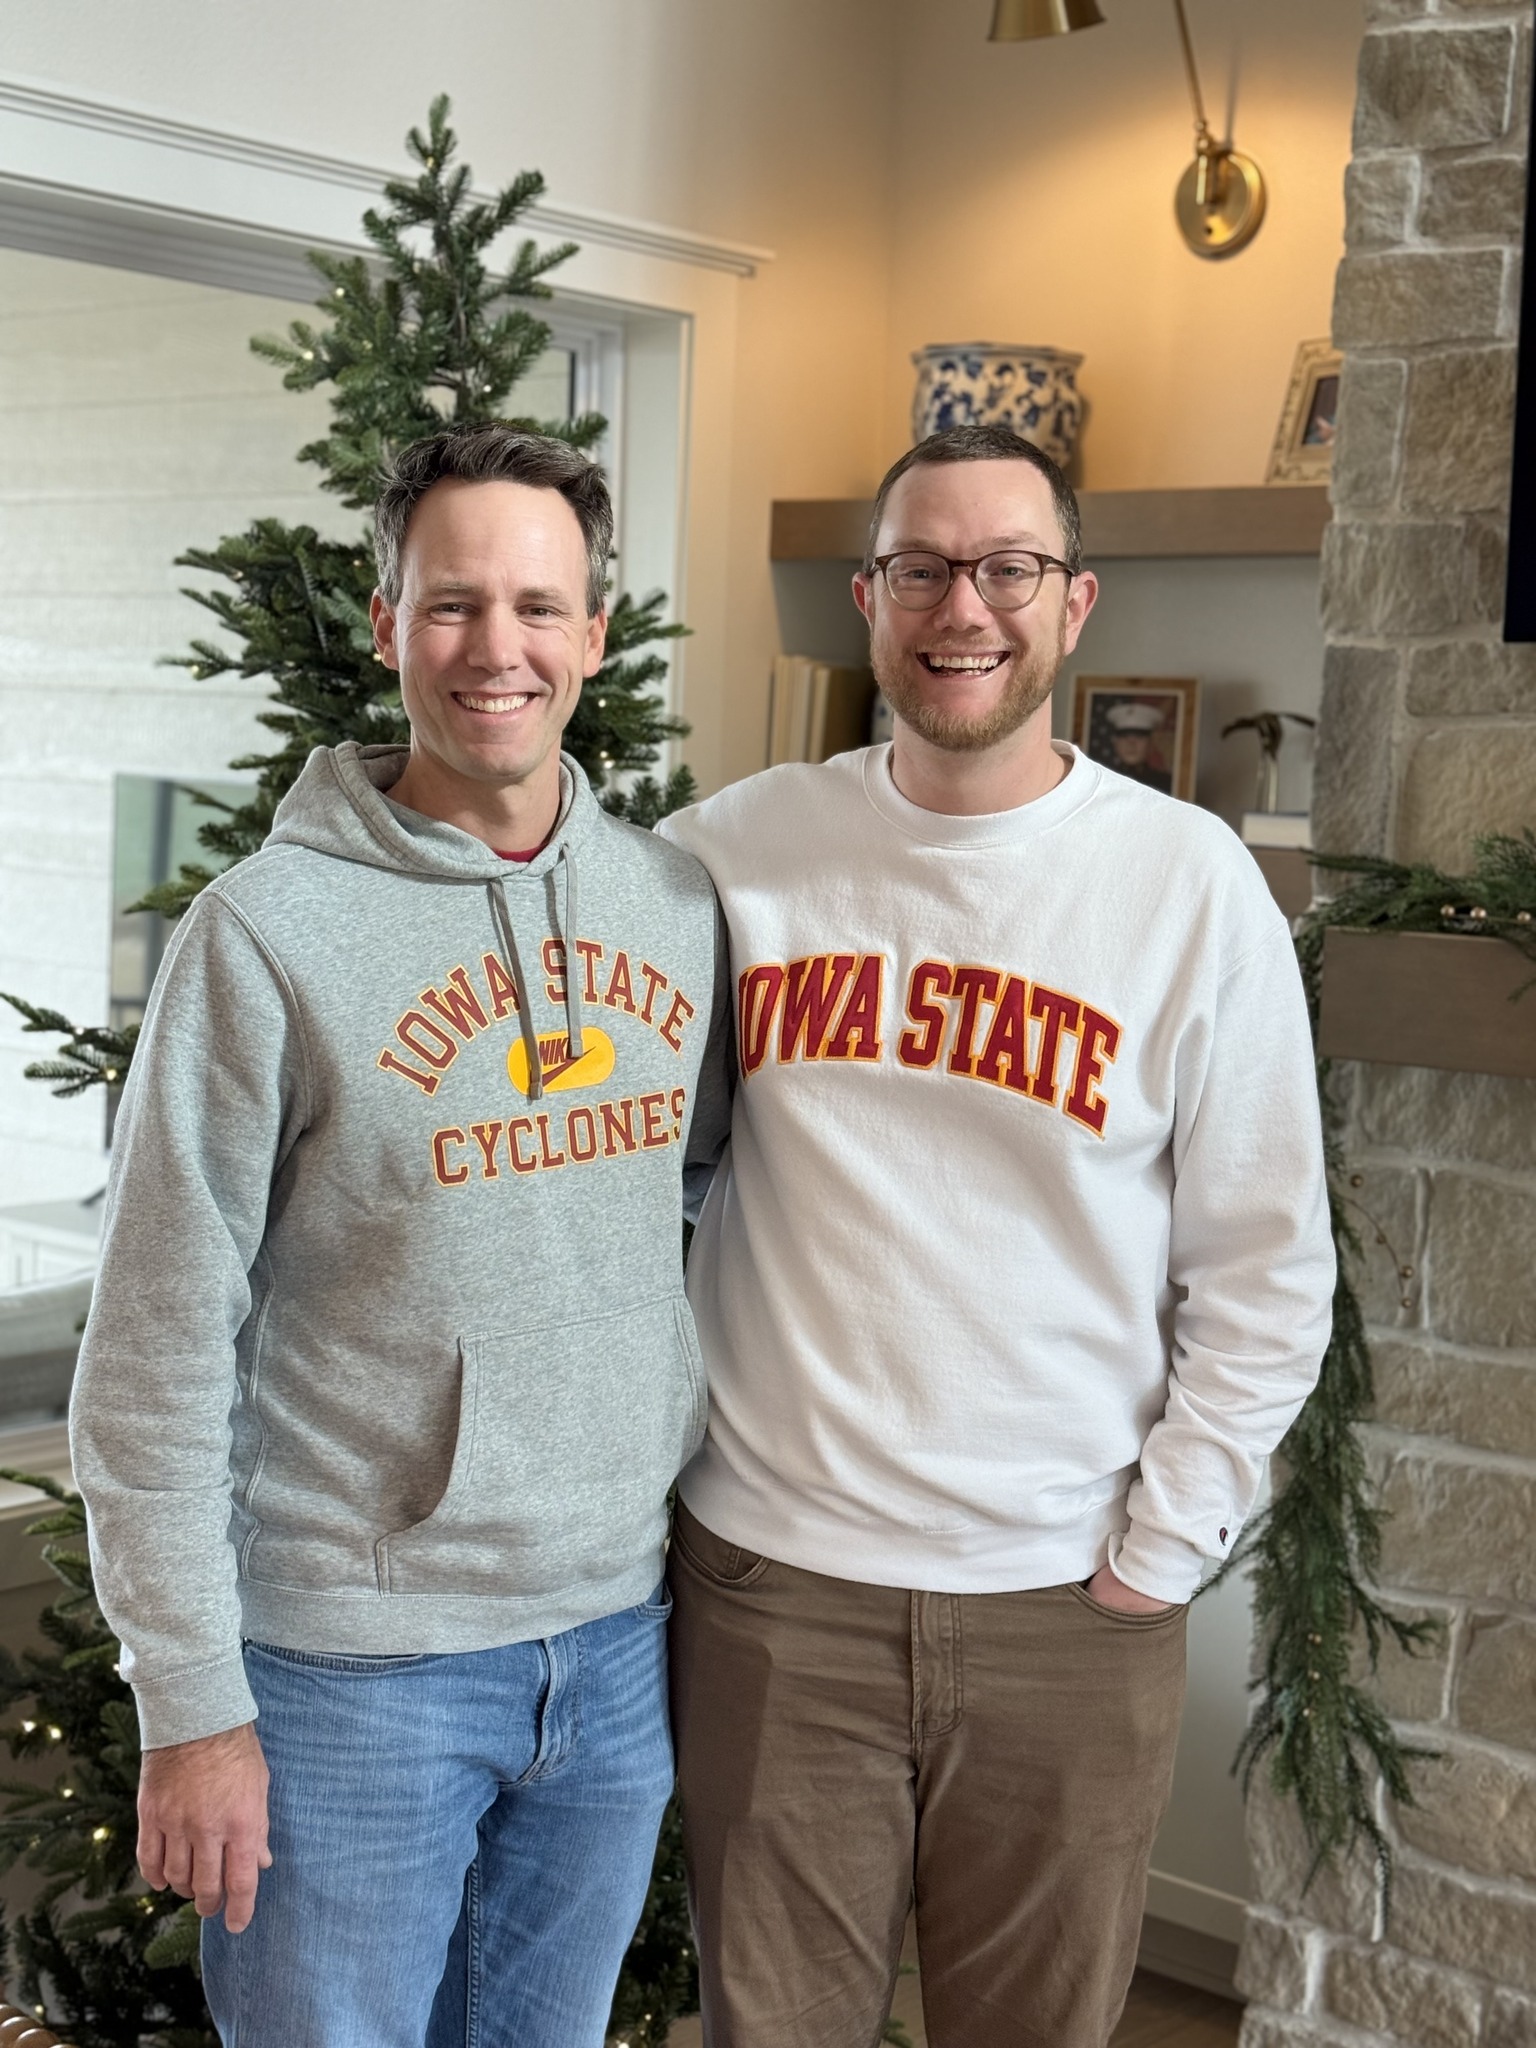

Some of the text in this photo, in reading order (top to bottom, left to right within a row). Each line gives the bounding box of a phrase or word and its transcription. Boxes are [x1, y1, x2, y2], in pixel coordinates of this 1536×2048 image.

[378, 938, 694, 1096] IOWA STATE
[538, 1037, 575, 1066] NIK
[899, 958, 1124, 1139] STATE
[432, 1087, 685, 1187] CYCLONES
